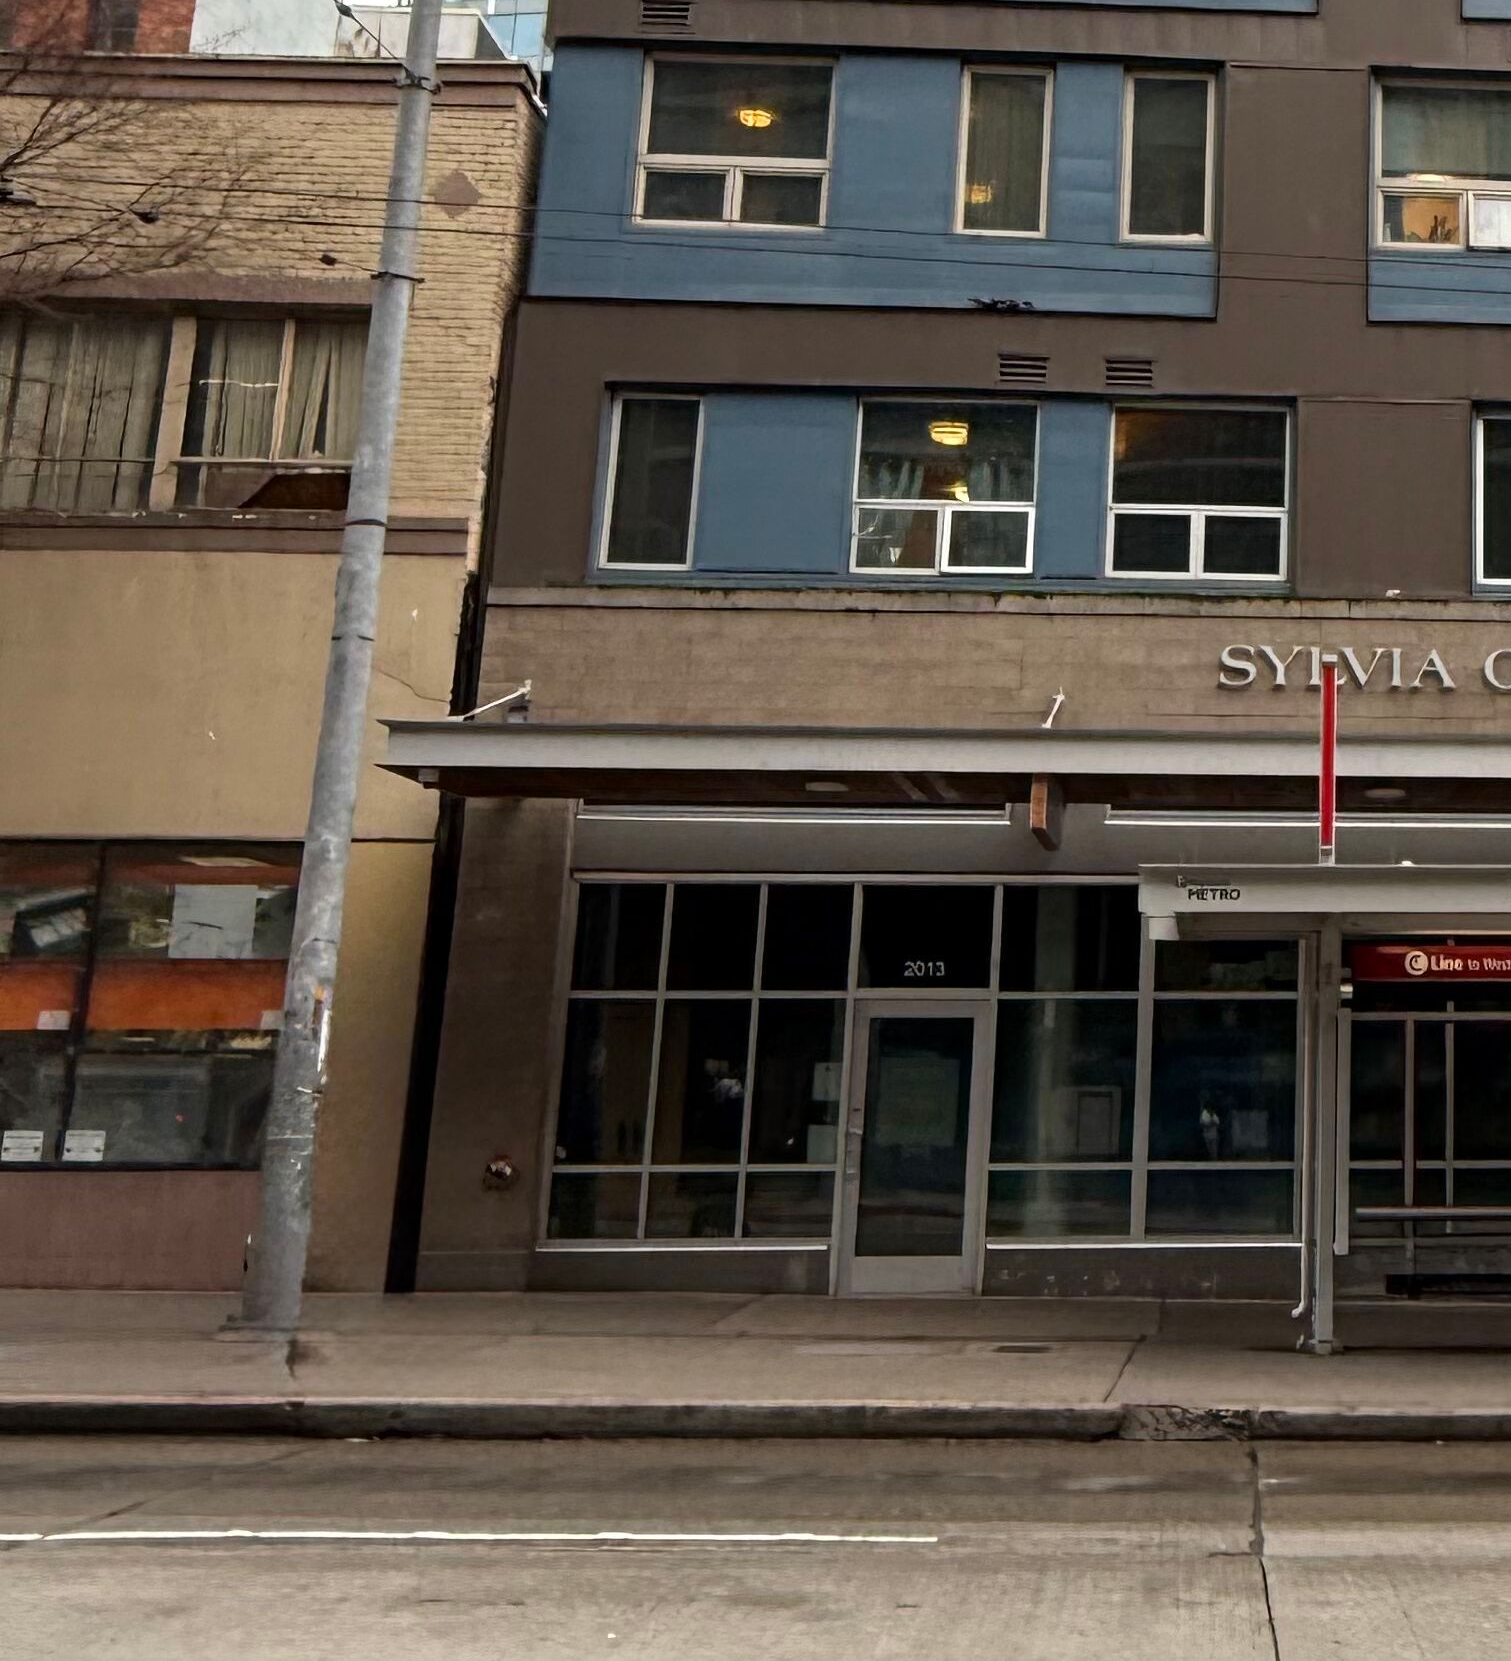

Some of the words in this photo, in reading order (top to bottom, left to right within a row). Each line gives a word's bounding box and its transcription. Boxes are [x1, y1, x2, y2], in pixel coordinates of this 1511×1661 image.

[1218, 644, 1456, 690] SYLVIA
[1187, 887, 1241, 900] METRO
[904, 960, 945, 977] 2013
[1430, 954, 1463, 971] Line
[1467, 957, 1480, 971] to
